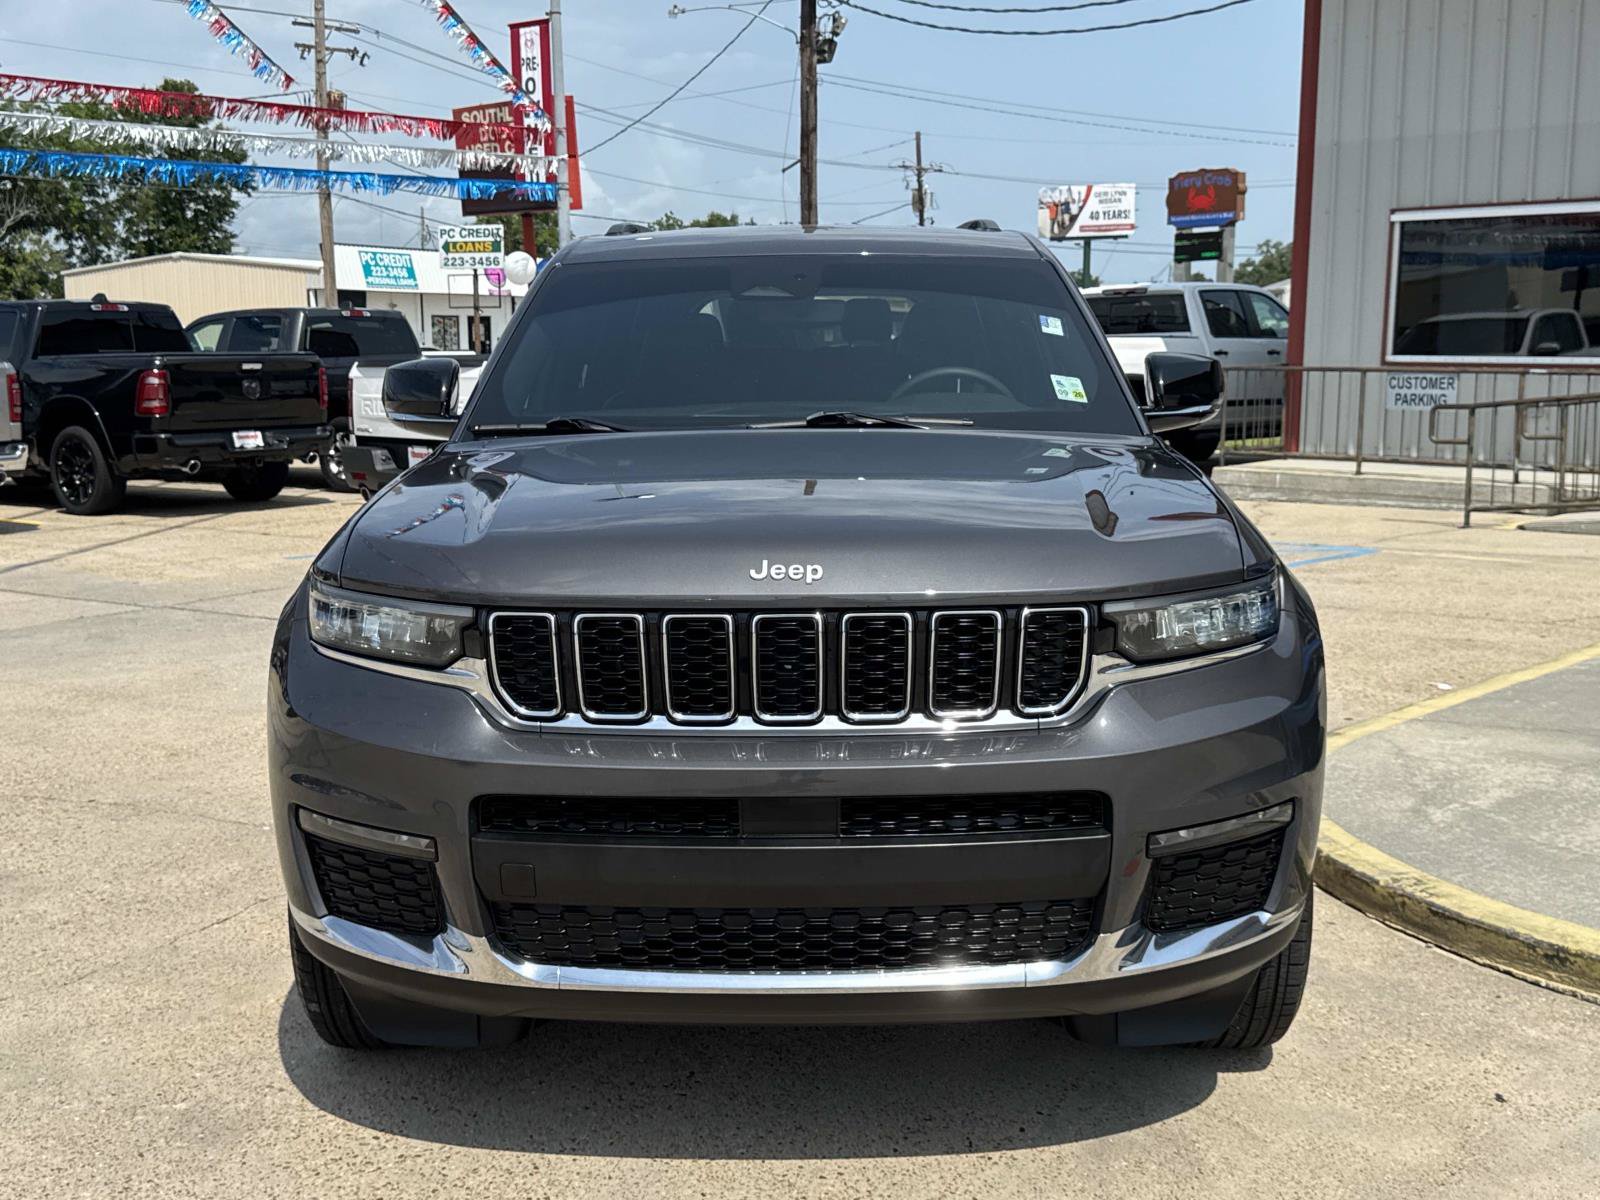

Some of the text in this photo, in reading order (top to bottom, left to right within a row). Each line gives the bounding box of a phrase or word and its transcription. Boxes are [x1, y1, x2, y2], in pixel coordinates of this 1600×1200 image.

[1089, 209, 1131, 220] 40 YEARS!
[440, 227, 502, 239] PC CREDIT
[449, 241, 493, 252] LOANS
[361, 253, 411, 268] PC CREDIT
[443, 256, 500, 267] 223-3456
[370, 267, 409, 278] 223-3456
[1388, 376, 1455, 391] CUSTOMER
[1394, 393, 1448, 406] PARKING
[749, 559, 823, 584] Jeep
